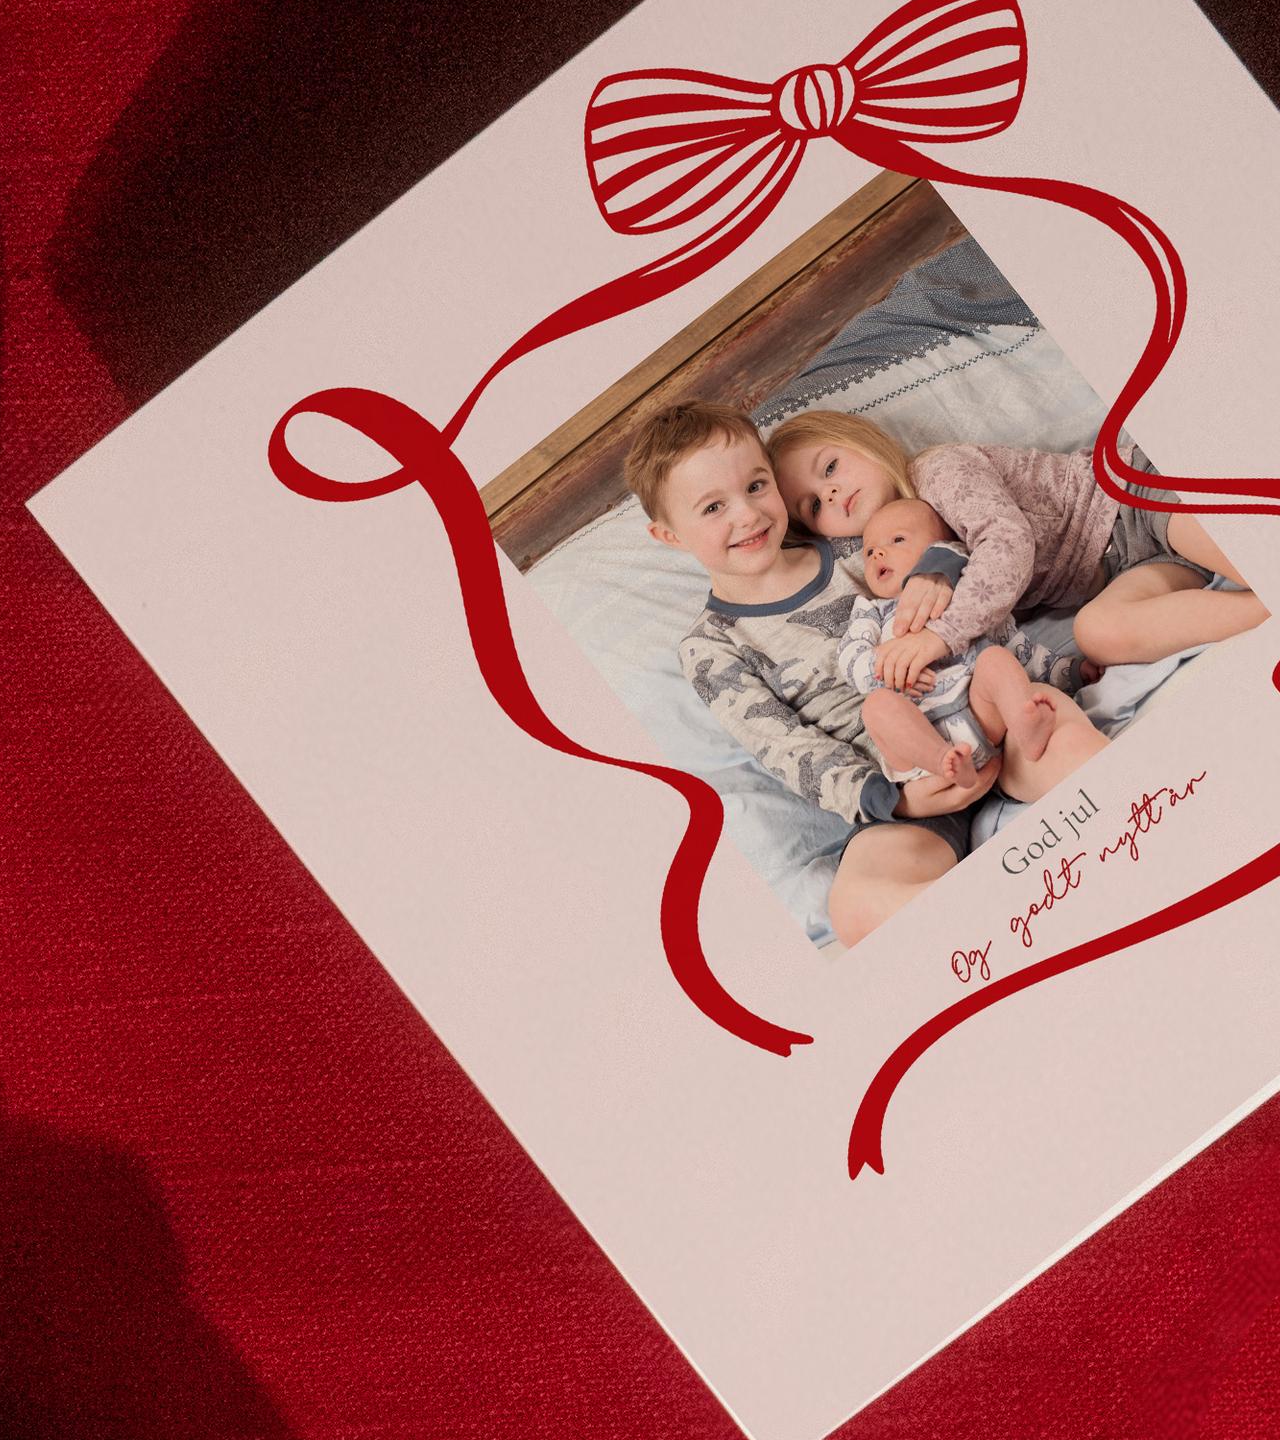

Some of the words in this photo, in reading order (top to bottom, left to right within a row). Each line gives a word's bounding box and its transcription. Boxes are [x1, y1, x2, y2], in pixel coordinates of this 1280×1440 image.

[950, 940, 993, 983] Og
[1009, 851, 1087, 948] godt
[1098, 787, 1169, 862] nytt
[1168, 770, 1207, 807] år
[1001, 818, 1063, 875] God
[1058, 788, 1101, 840] jul
